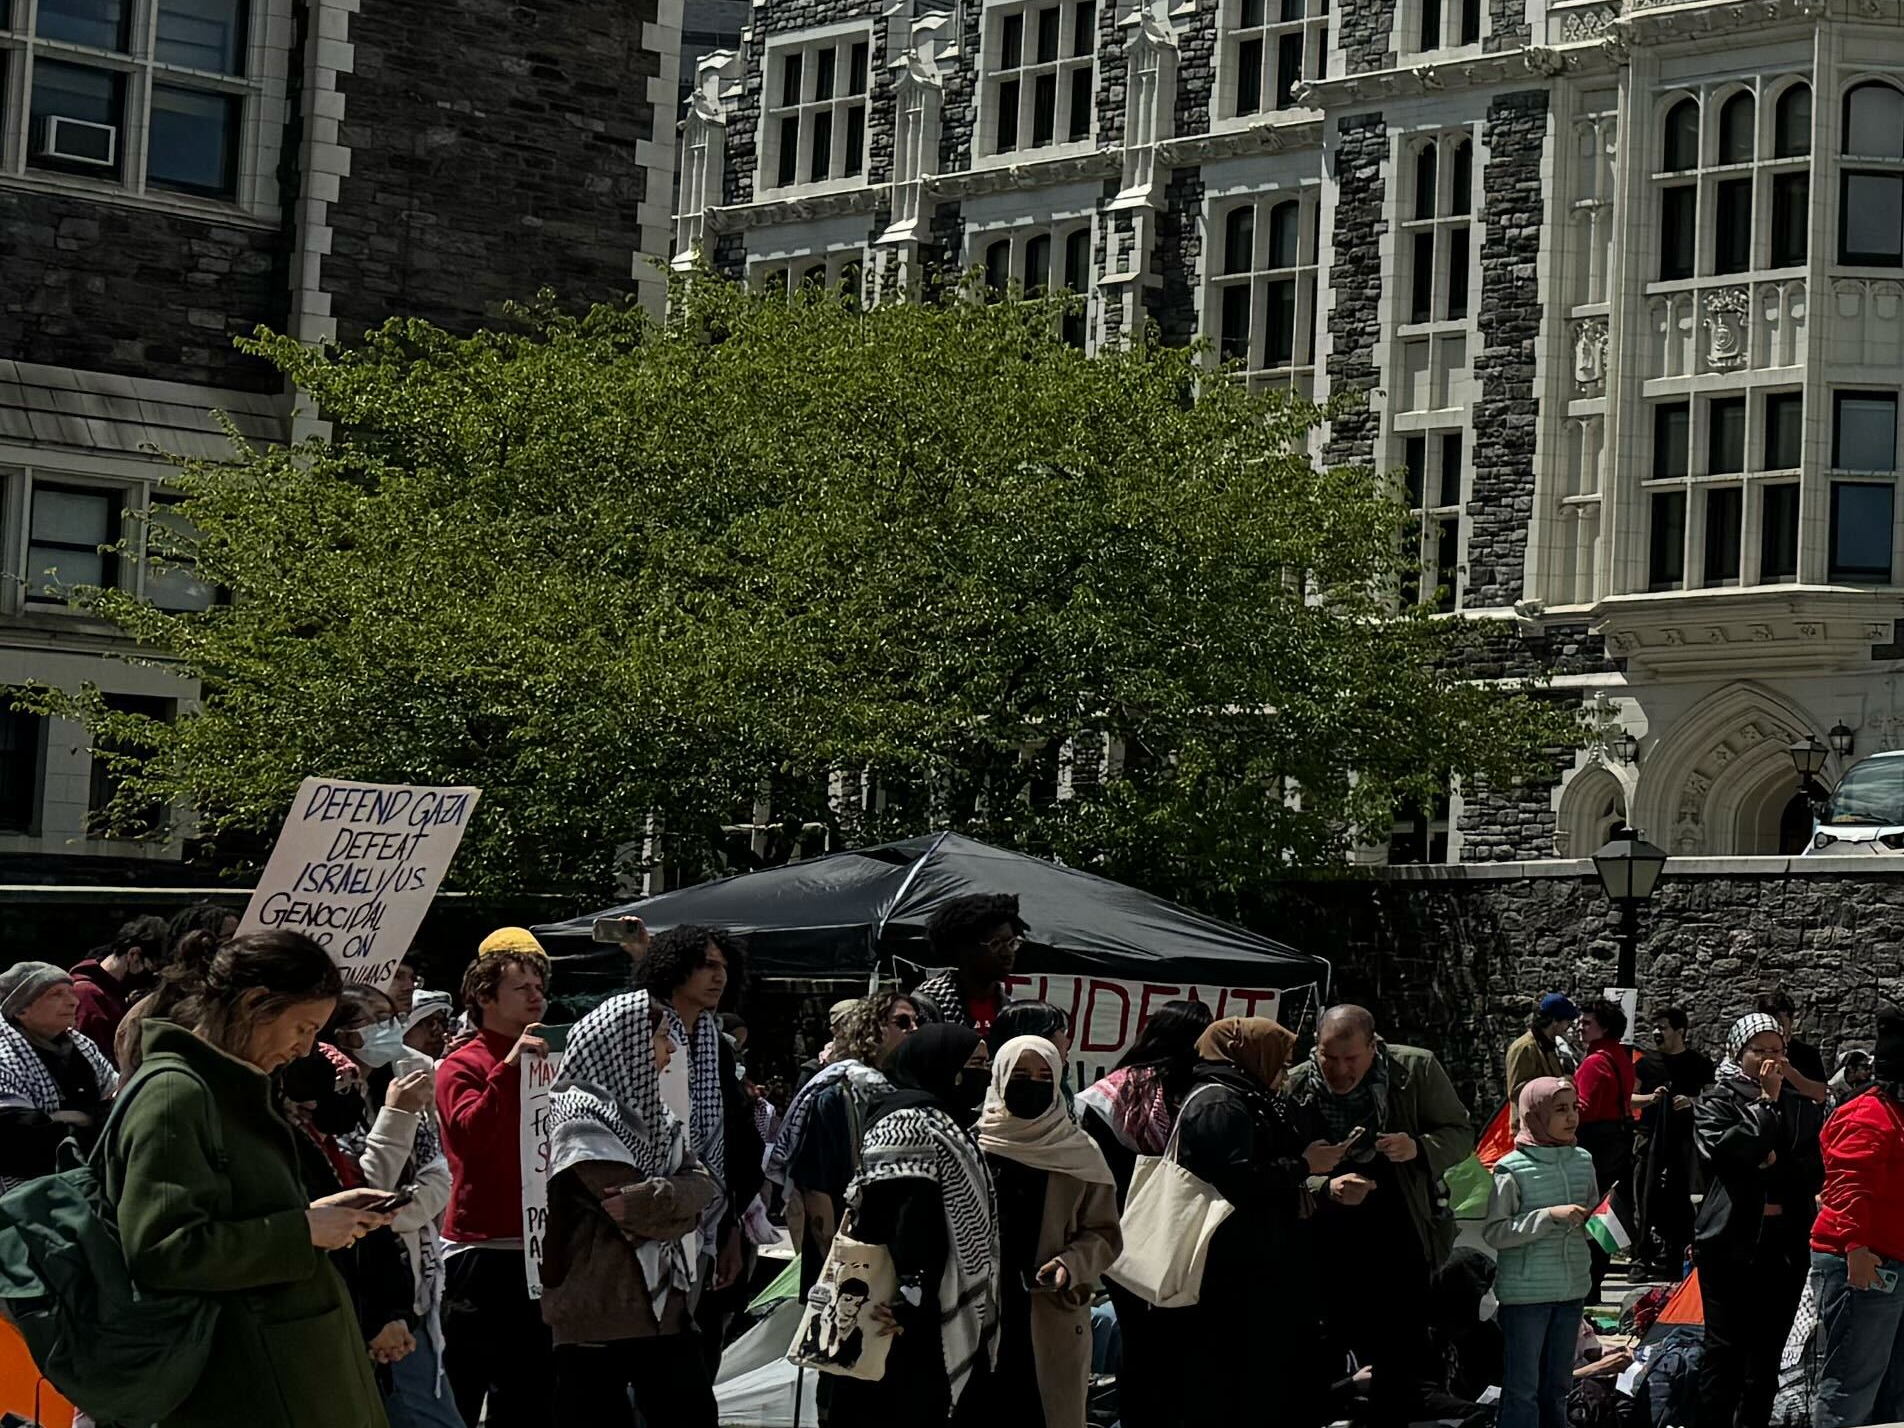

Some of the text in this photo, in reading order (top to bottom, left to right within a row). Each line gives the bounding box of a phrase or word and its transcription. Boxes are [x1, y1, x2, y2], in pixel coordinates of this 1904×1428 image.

[303, 784, 470, 827] DEFEND GAZA
[326, 820, 429, 862] DEFEAT
[292, 861, 427, 904] ISRAELI/US
[259, 892, 388, 933] GENOCIDAL
[342, 932, 377, 958] ON
